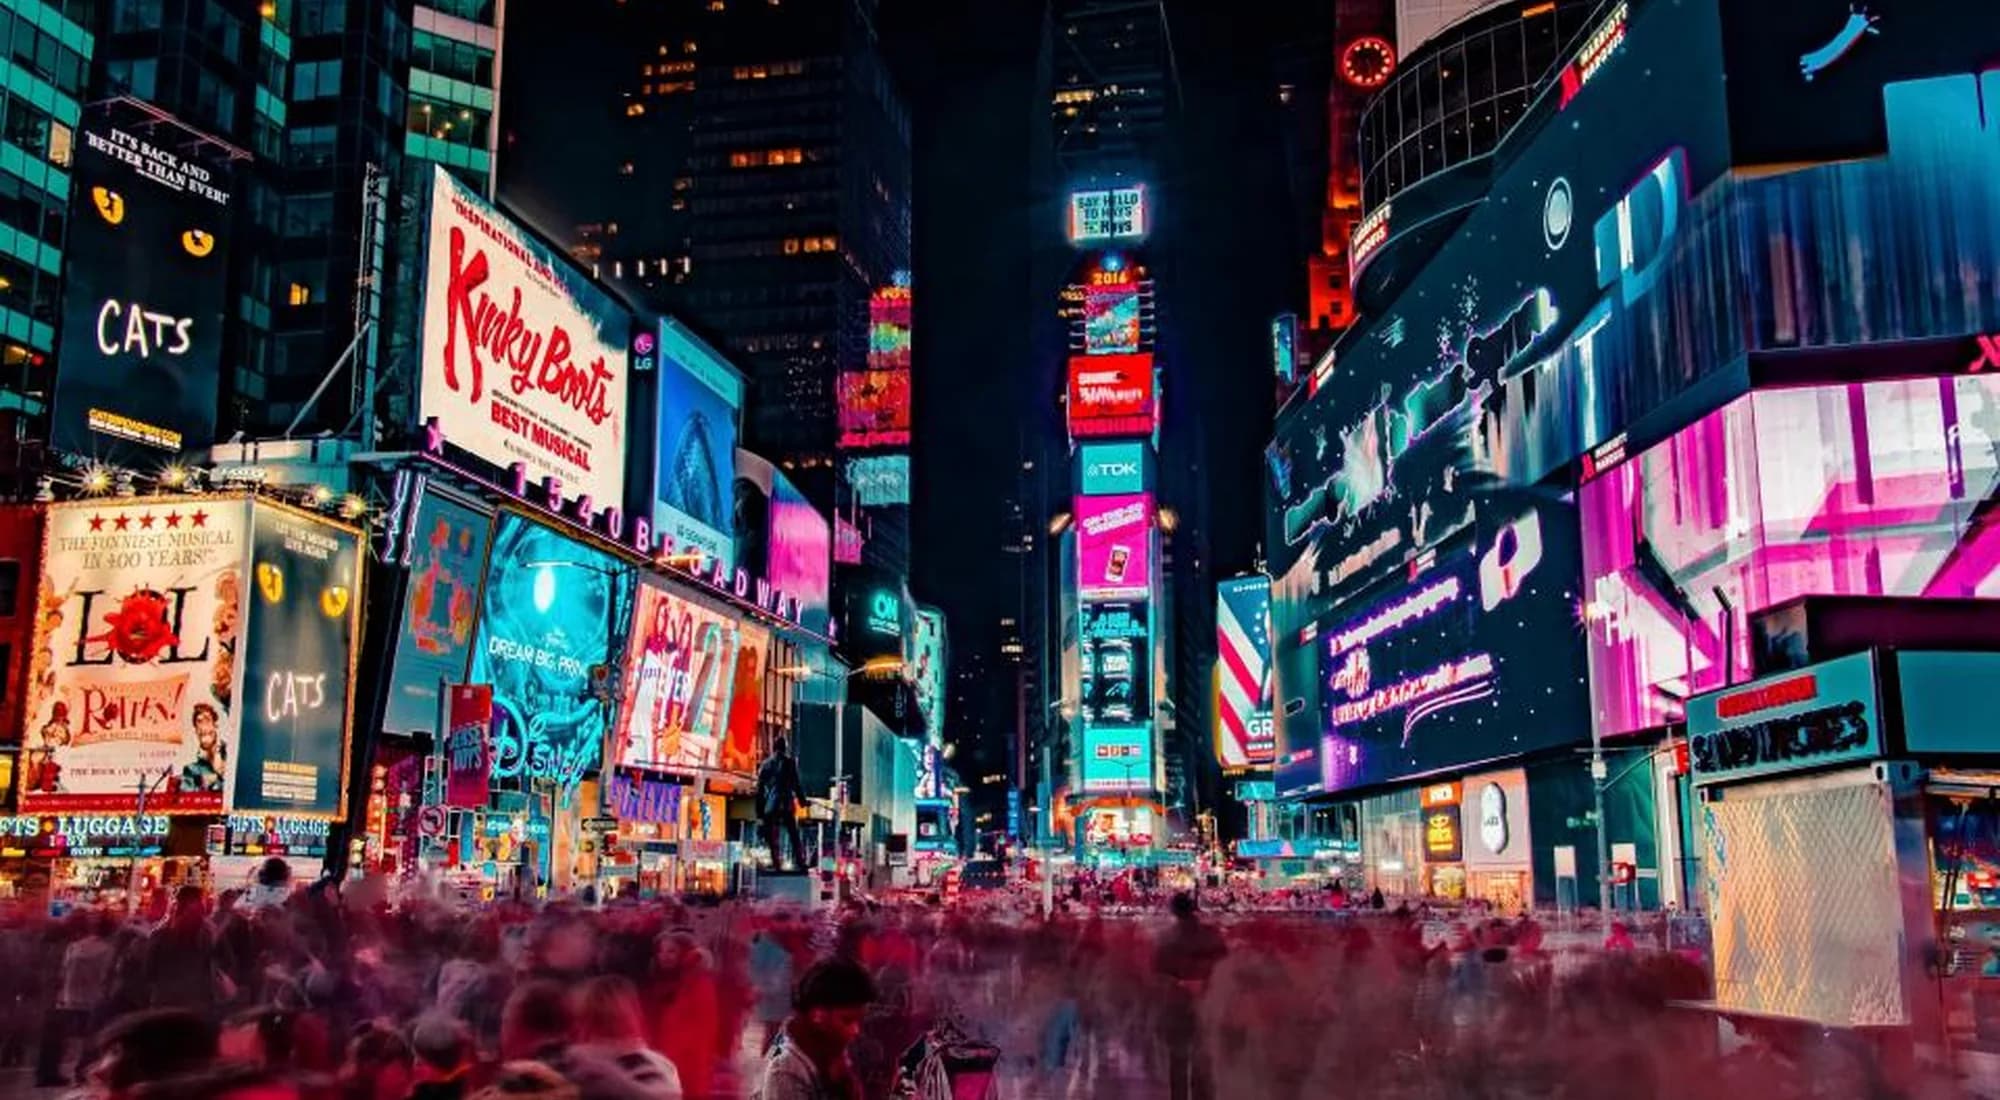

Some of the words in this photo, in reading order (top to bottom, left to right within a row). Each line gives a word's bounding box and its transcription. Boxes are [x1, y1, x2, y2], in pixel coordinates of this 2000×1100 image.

[110, 128, 139, 150] IT'S
[140, 141, 177, 168] BACK
[180, 161, 210, 182] AND
[145, 159, 187, 187] THAN
[1092, 271, 1129, 286] 2016
[97, 299, 193, 358] CATS
[444, 226, 542, 403] Kinky
[537, 325, 614, 425] Boots
[635, 358, 653, 371] LG
[491, 401, 530, 439] BEST
[531, 421, 592, 473] MUSICAL
[1098, 463, 1137, 476] TDK
[514, 461, 623, 540] 1540
[168, 530, 234, 549] MUSICAL
[82, 551, 101, 569] IN
[107, 551, 141, 568] 400
[875, 594, 898, 621] ON
[490, 635, 534, 663] DREAM
[266, 671, 326, 723] CATS
[58, 815, 171, 836] LUGGAGE
